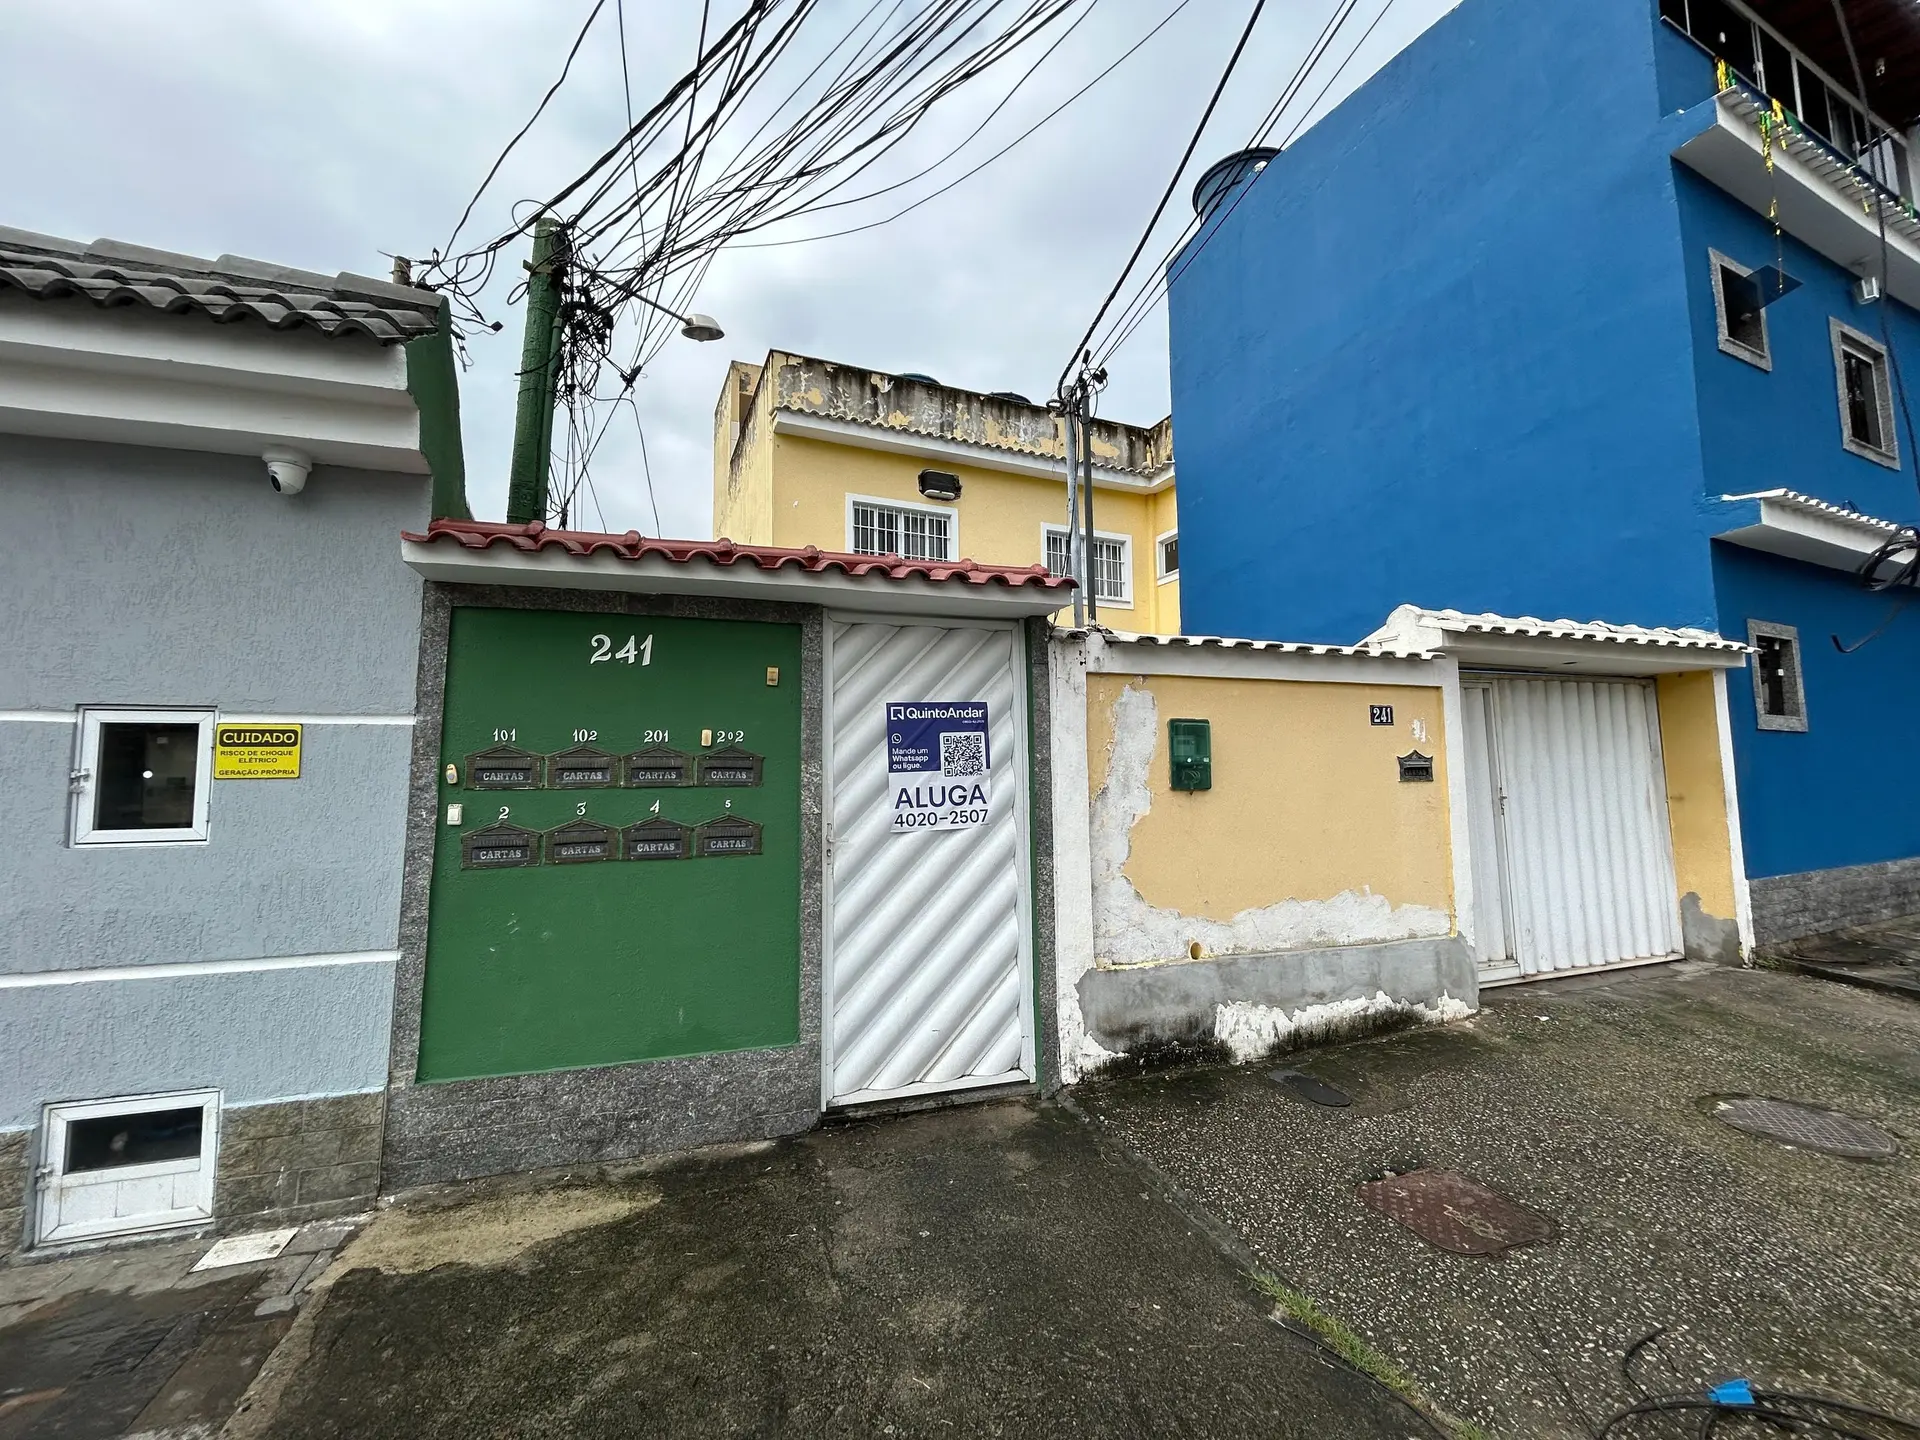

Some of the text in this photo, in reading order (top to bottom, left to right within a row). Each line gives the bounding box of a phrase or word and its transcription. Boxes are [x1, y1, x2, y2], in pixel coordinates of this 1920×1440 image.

[590, 634, 653, 666] 241
[906, 707, 984, 719] QuintoAndar
[1373, 707, 1392, 723] 241
[222, 732, 295, 743] CUIDADO
[492, 728, 516, 741] 101
[572, 729, 598, 742] 102
[643, 730, 669, 743] 201
[716, 730, 744, 743] 202
[902, 762, 922, 770] ligue.
[483, 772, 524, 780] CARTAS
[563, 771, 603, 780] CARTAS
[639, 771, 676, 779] CARTAS
[711, 771, 747, 779] CARTAS
[895, 784, 987, 809] ALUGA
[576, 801, 586, 815] 3
[649, 800, 660, 813] 4
[725, 800, 731, 808] 5
[498, 806, 509, 820] 2
[894, 809, 988, 827] 4020-2507
[561, 845, 601, 855] CARTAS
[637, 843, 675, 852] CARTAS
[710, 840, 747, 848] CARTAS
[480, 850, 521, 859] CARTAS
